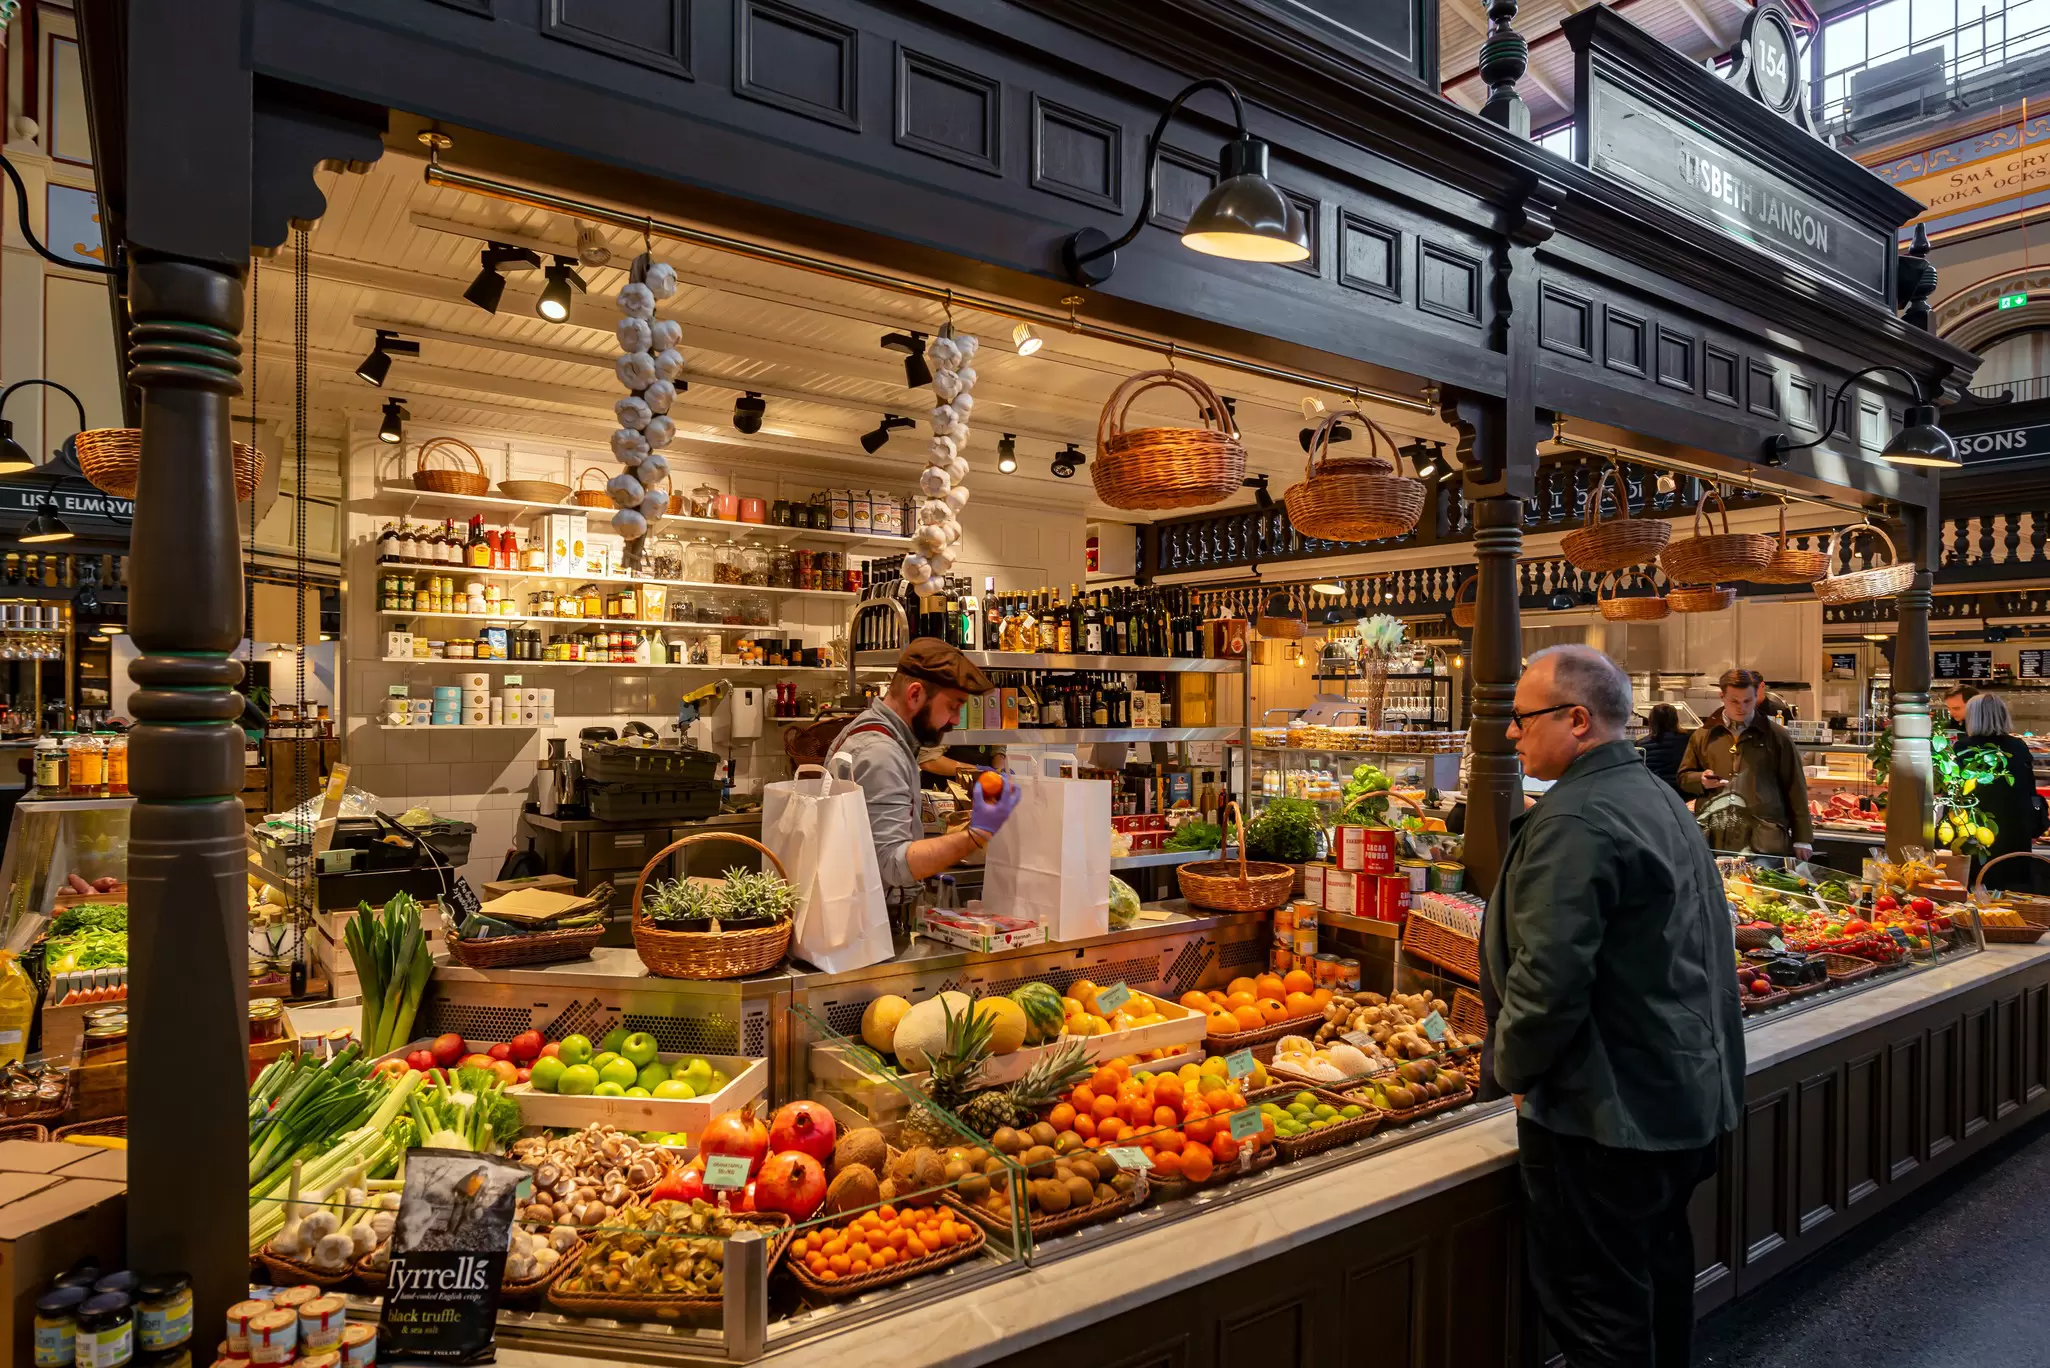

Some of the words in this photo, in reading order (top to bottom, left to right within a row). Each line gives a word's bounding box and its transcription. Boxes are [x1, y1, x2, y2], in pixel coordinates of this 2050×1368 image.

[1759, 39, 1787, 84] 154
[1950, 167, 1994, 188] SMÅ
[1682, 150, 1753, 215] LISBETH
[1758, 192, 1828, 253] JANSON
[1930, 186, 1982, 207] KOKA
[1953, 431, 2027, 455] SONS
[21, 494, 58, 507] LISA
[65, 497, 136, 514] ELMQVI
[1365, 851, 1389, 860] POWDER
[438, 1292, 463, 1301] English
[388, 1308, 418, 1322] black
[422, 1308, 462, 1322] truffle
[401, 1326, 409, 1334] &
[424, 1325, 439, 1334] salt
